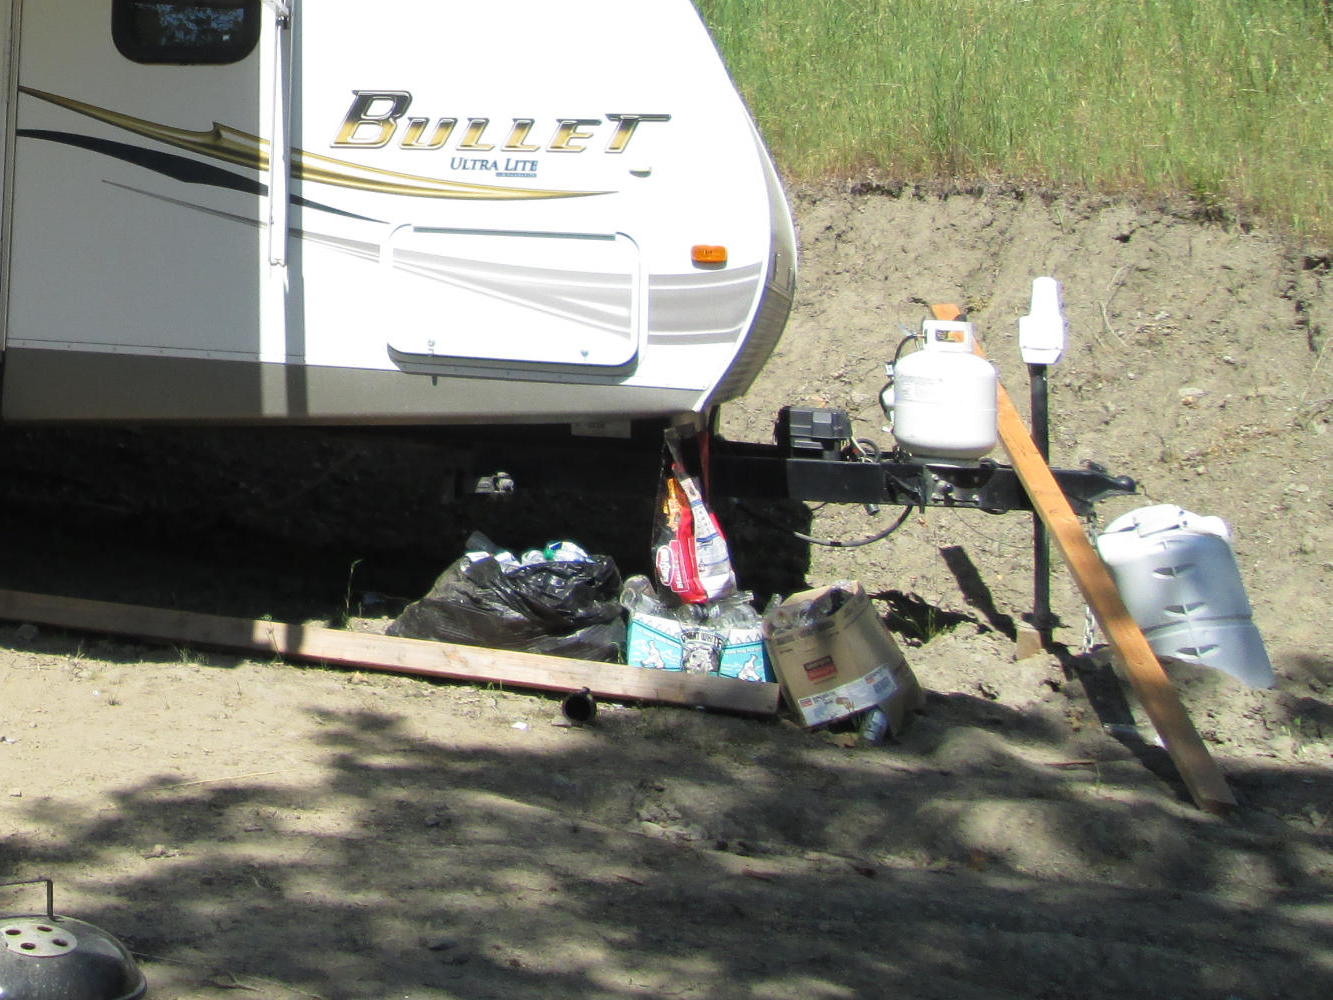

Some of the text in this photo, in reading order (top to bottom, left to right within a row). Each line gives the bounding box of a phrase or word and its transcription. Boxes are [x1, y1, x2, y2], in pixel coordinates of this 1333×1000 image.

[330, 89, 672, 153] BULLET
[450, 157, 539, 172] ULTRA LITE
